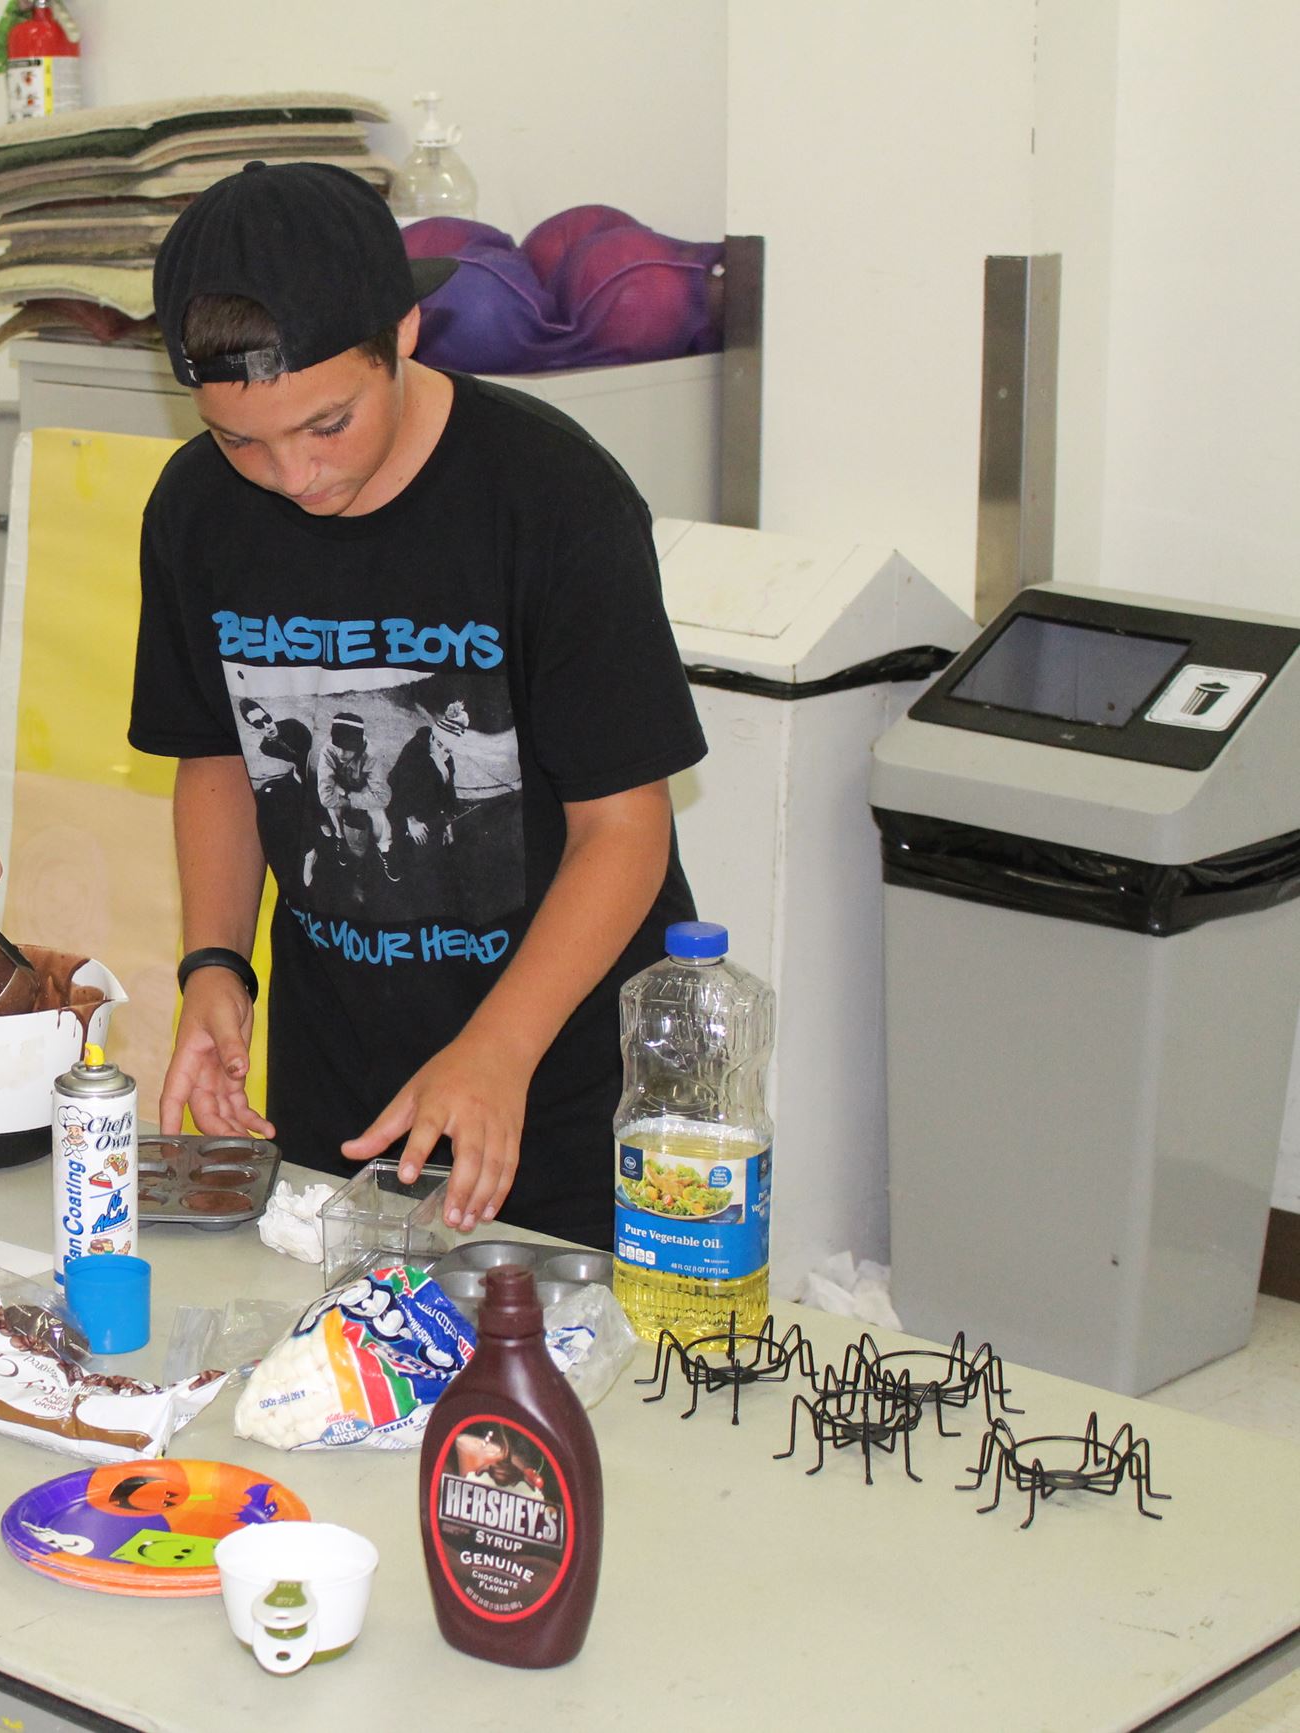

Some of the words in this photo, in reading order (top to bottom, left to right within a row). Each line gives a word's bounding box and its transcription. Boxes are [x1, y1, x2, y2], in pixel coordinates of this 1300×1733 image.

[212, 611, 375, 665] BEASTIE
[382, 618, 503, 669] BOYS
[330, 920, 413, 966] YOUR
[420, 925, 509, 964] HEAD
[87, 1111, 133, 1136] Chef's
[95, 1133, 132, 1152] Own
[63, 1159, 87, 1236] Coating
[624, 1223, 648, 1238] Pure
[649, 1230, 700, 1249] Vegetable
[703, 1238, 721, 1250] Oil
[259, 1398, 276, 1409] FOOD
[291, 1391, 300, 1401] FAT
[332, 1420, 356, 1435] RICE
[445, 1479, 558, 1542] HERSHEY'S
[475, 1530, 523, 1552] SYRUP
[460, 1551, 534, 1582] GENUINE
[472, 1570, 518, 1590] CHOCOLATE
[478, 1580, 509, 1596] FLAVOR
